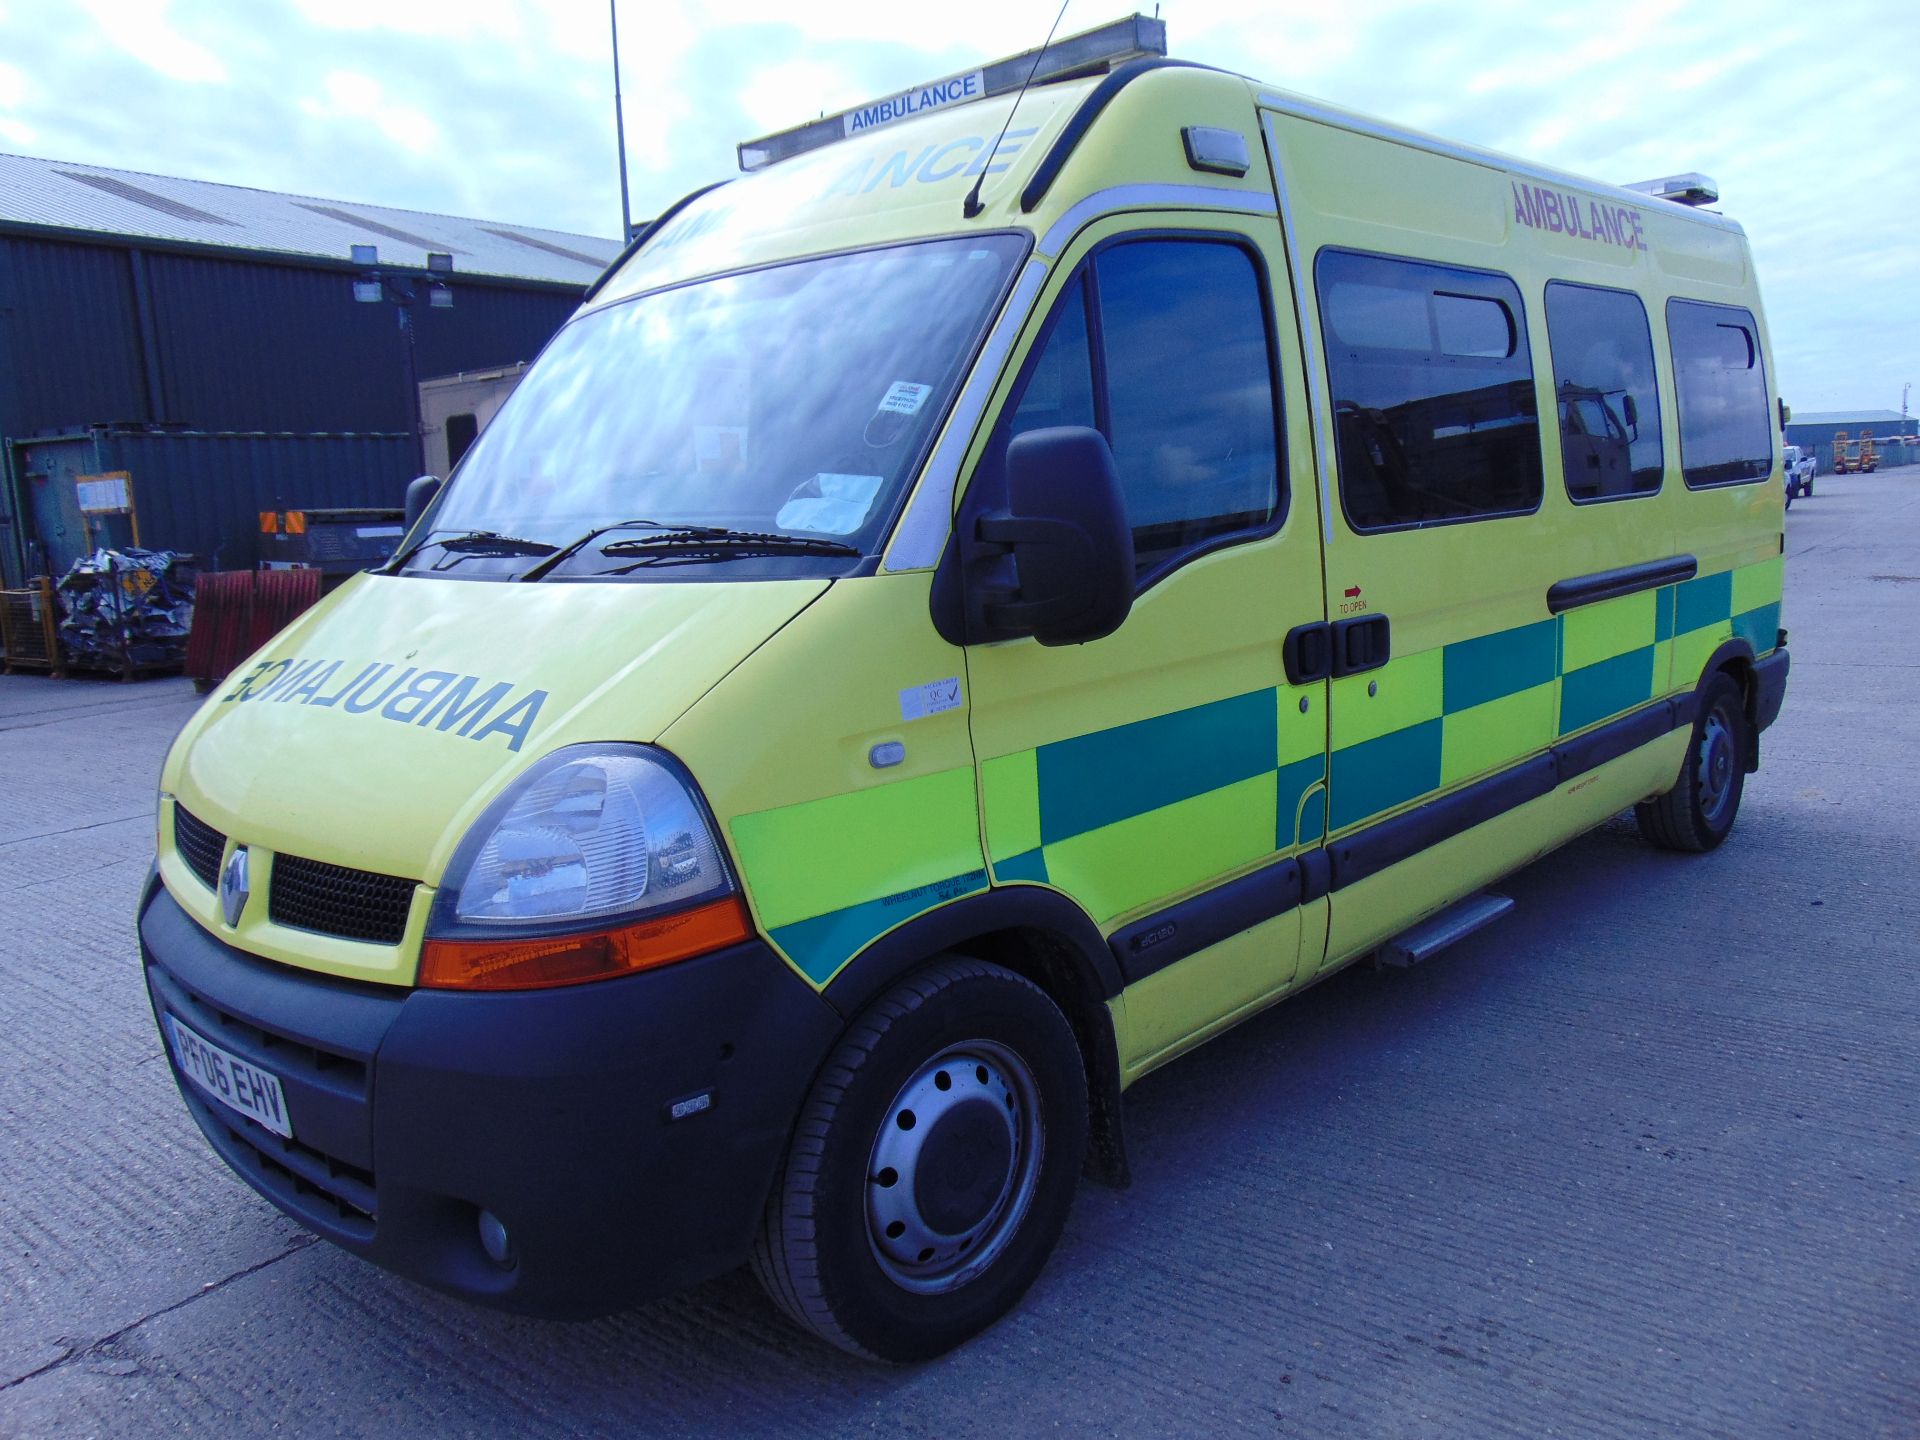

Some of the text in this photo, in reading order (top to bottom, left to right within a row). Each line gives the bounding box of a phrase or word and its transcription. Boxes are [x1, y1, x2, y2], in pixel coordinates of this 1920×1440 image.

[850, 74, 977, 132] AMBULANCE
[1511, 180, 1648, 252] AMBULANCE
[1339, 600, 1367, 614] TO OPEN
[175, 1026, 282, 1124] PF06 EHV
